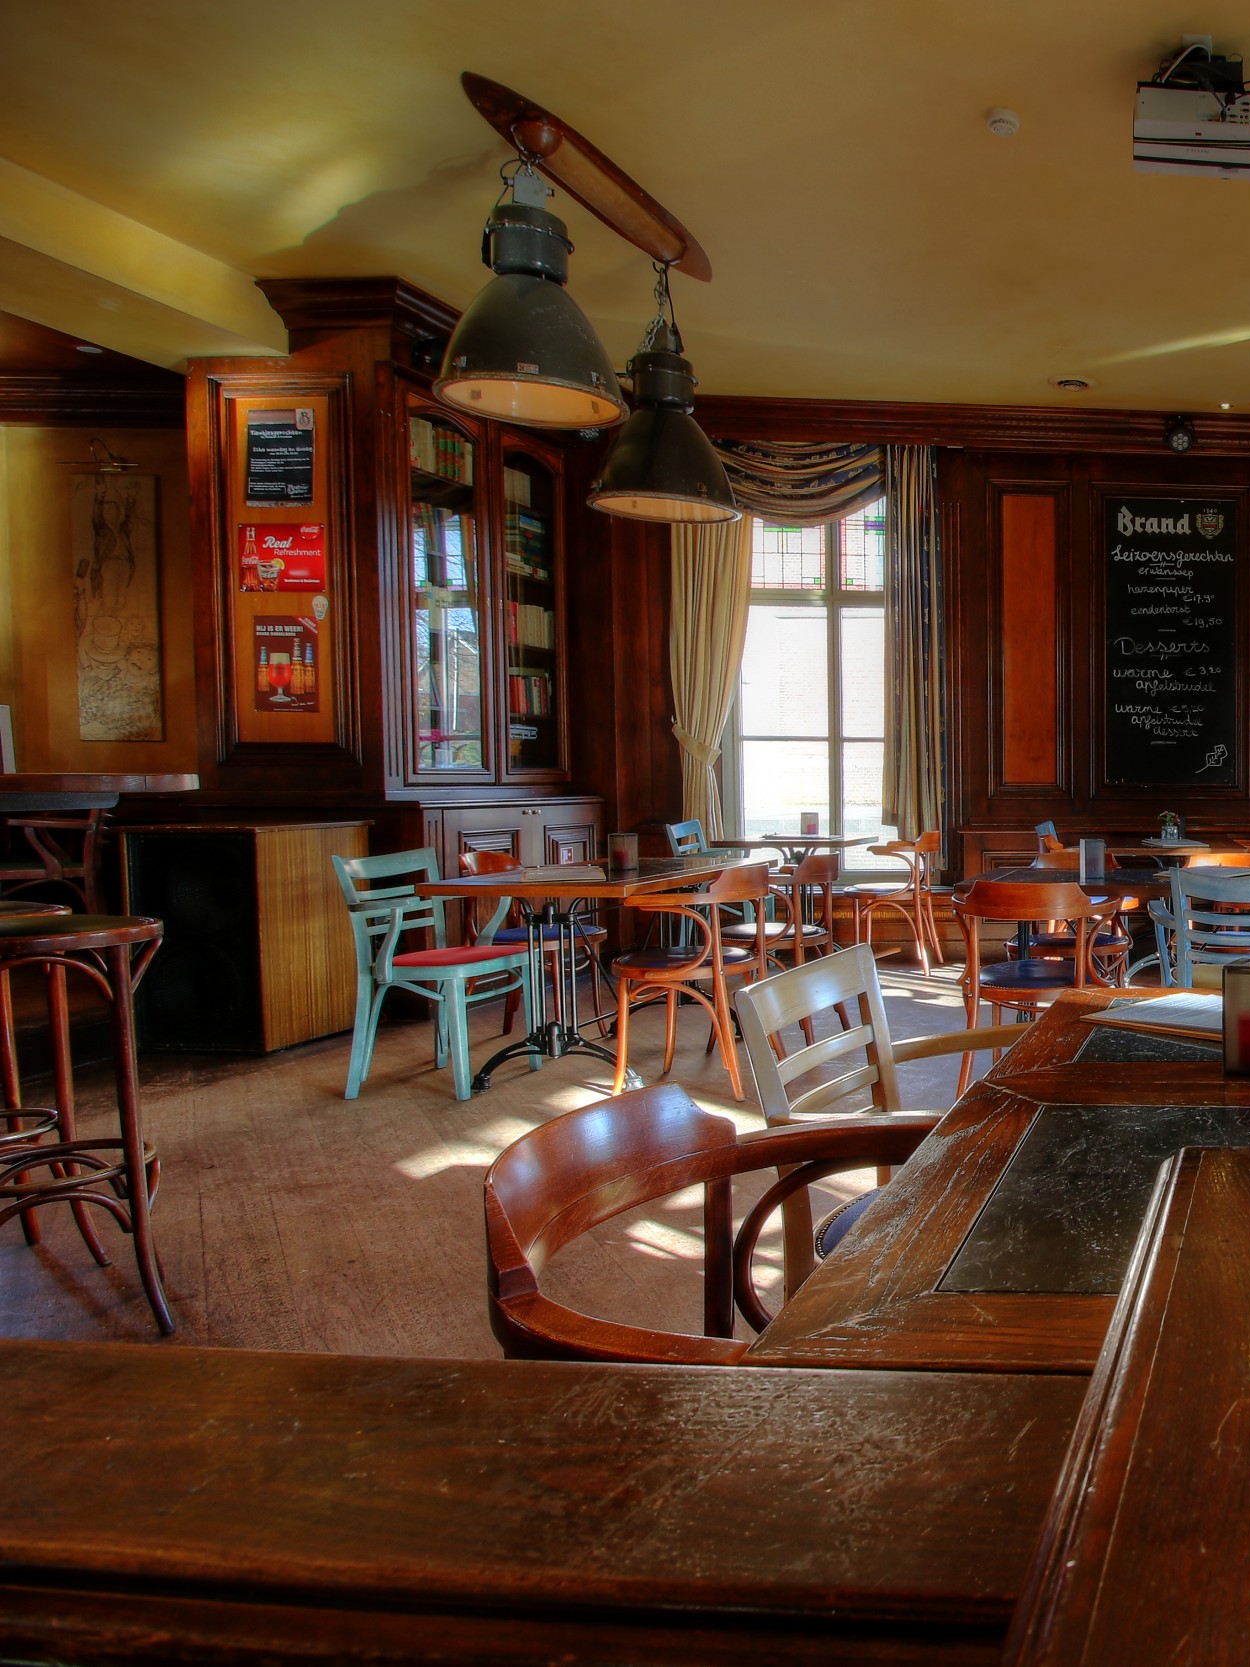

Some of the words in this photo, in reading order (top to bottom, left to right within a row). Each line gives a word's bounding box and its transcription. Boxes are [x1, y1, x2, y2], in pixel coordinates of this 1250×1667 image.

[1117, 506, 1191, 536] Brand
[262, 536, 293, 549] Real
[1113, 637, 1210, 656] Desserts
[1113, 669, 1173, 679] warme
[1135, 680, 1217, 697] apfelstrudel
[1115, 703, 1163, 714] warme
